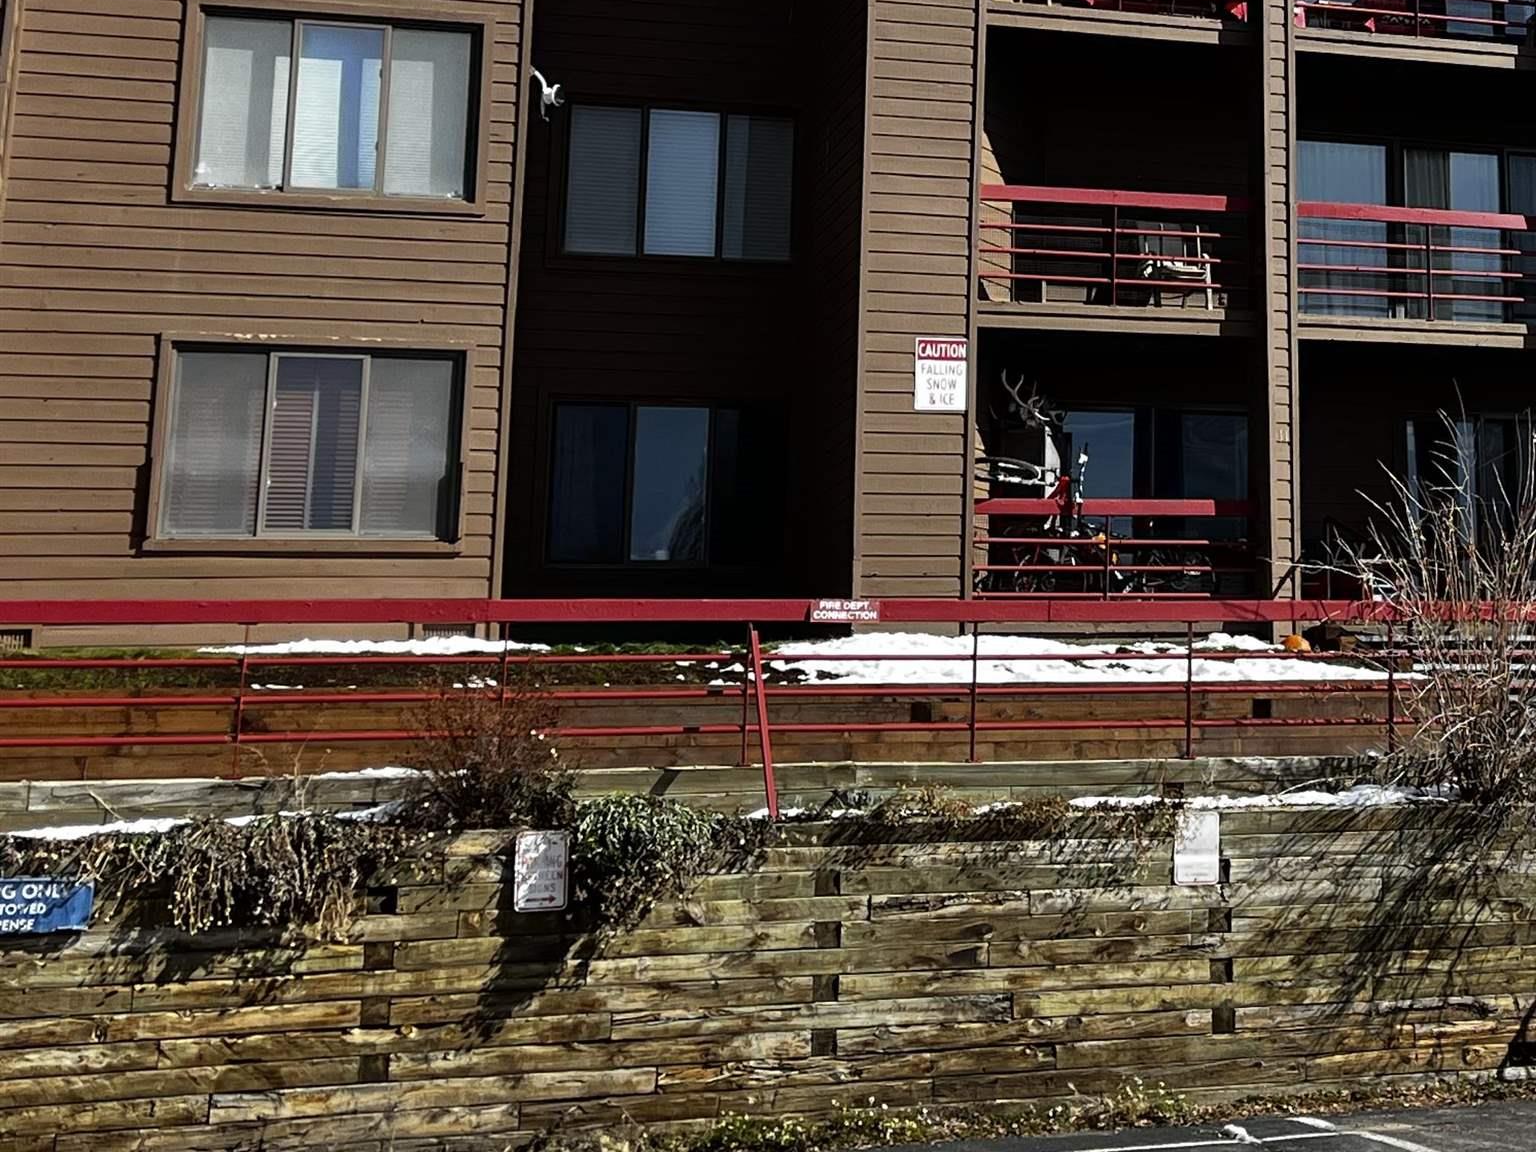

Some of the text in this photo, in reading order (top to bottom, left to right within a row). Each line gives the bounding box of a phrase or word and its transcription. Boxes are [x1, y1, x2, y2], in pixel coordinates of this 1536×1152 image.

[919, 342, 967, 358] CAUTION
[921, 363, 963, 376] FALLING
[926, 378, 957, 390] SNOW
[929, 393, 955, 405] & ICE
[820, 600, 872, 610] FIRE DEPT.
[813, 611, 877, 620] CONNECTION
[22, 884, 64, 899] ONL
[0, 918, 35, 931] ENSE
